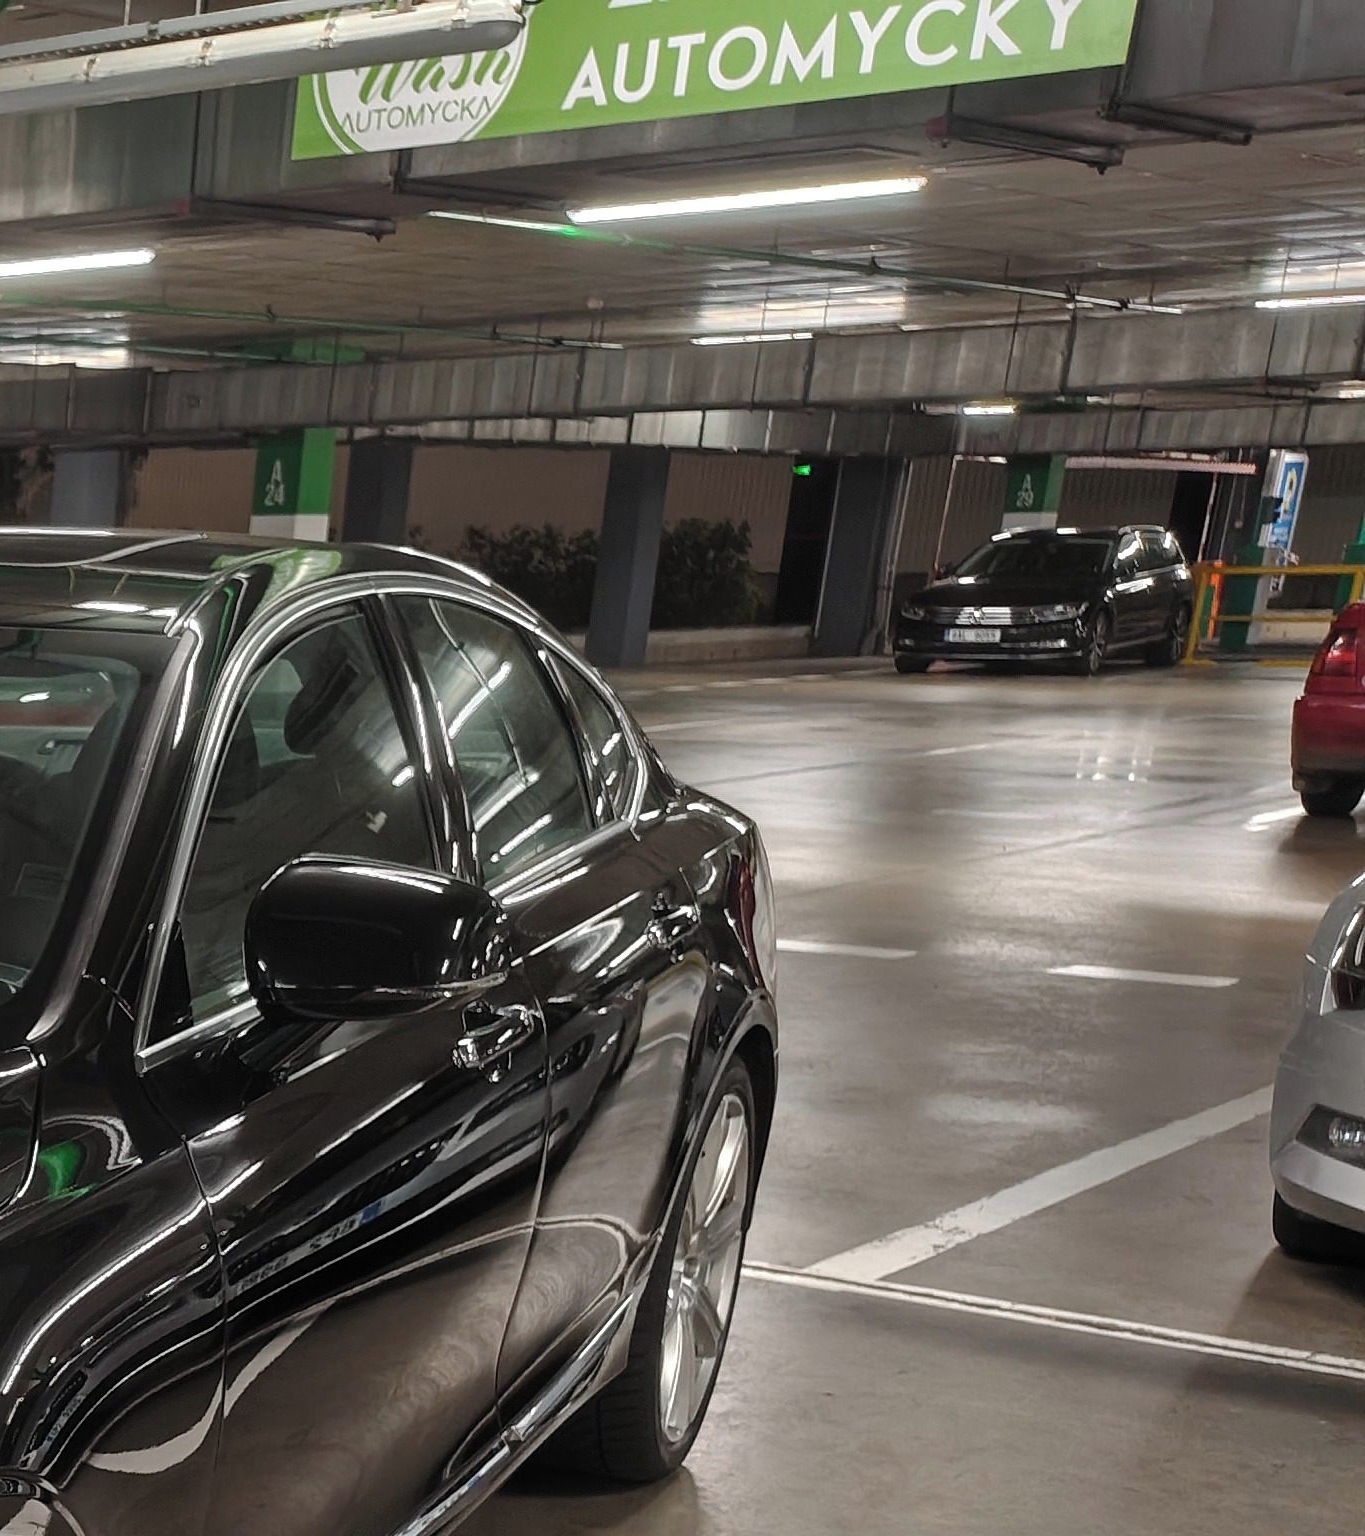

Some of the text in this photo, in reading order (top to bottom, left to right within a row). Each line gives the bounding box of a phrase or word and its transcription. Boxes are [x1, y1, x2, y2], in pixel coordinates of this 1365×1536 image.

[562, 0, 1075, 111] AUTOMYCKY
[341, 96, 495, 134] AUTOMYCKA
[271, 460, 282, 485] A
